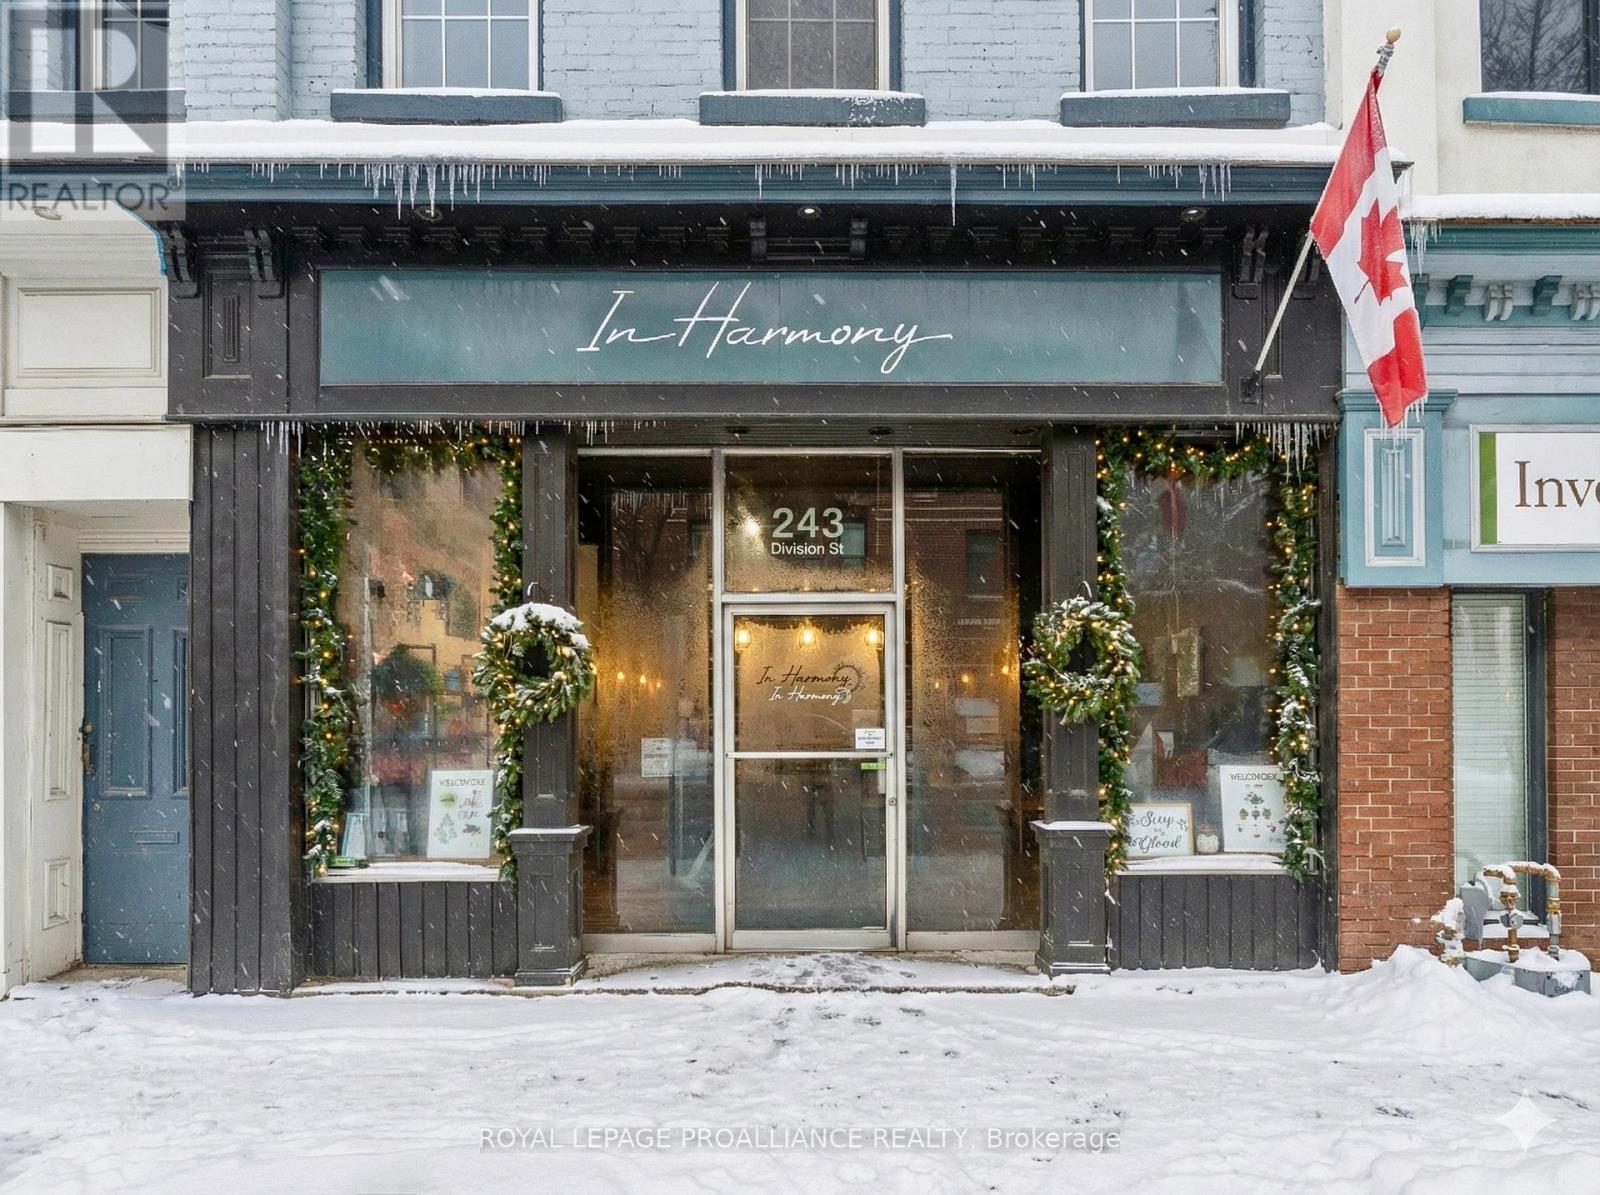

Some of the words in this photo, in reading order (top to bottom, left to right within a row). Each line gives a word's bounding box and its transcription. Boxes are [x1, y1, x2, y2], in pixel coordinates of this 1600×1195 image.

[577, 290, 676, 352] In
[674, 281, 953, 374] Harmony
[1514, 460, 1600, 508] Inv
[771, 507, 844, 539] 243
[770, 542, 826, 556] Division
[829, 542, 845, 556] St
[756, 665, 776, 685] In
[781, 664, 852, 687] Harmony
[768, 685, 784, 701] In
[787, 685, 841, 706] Harmony
